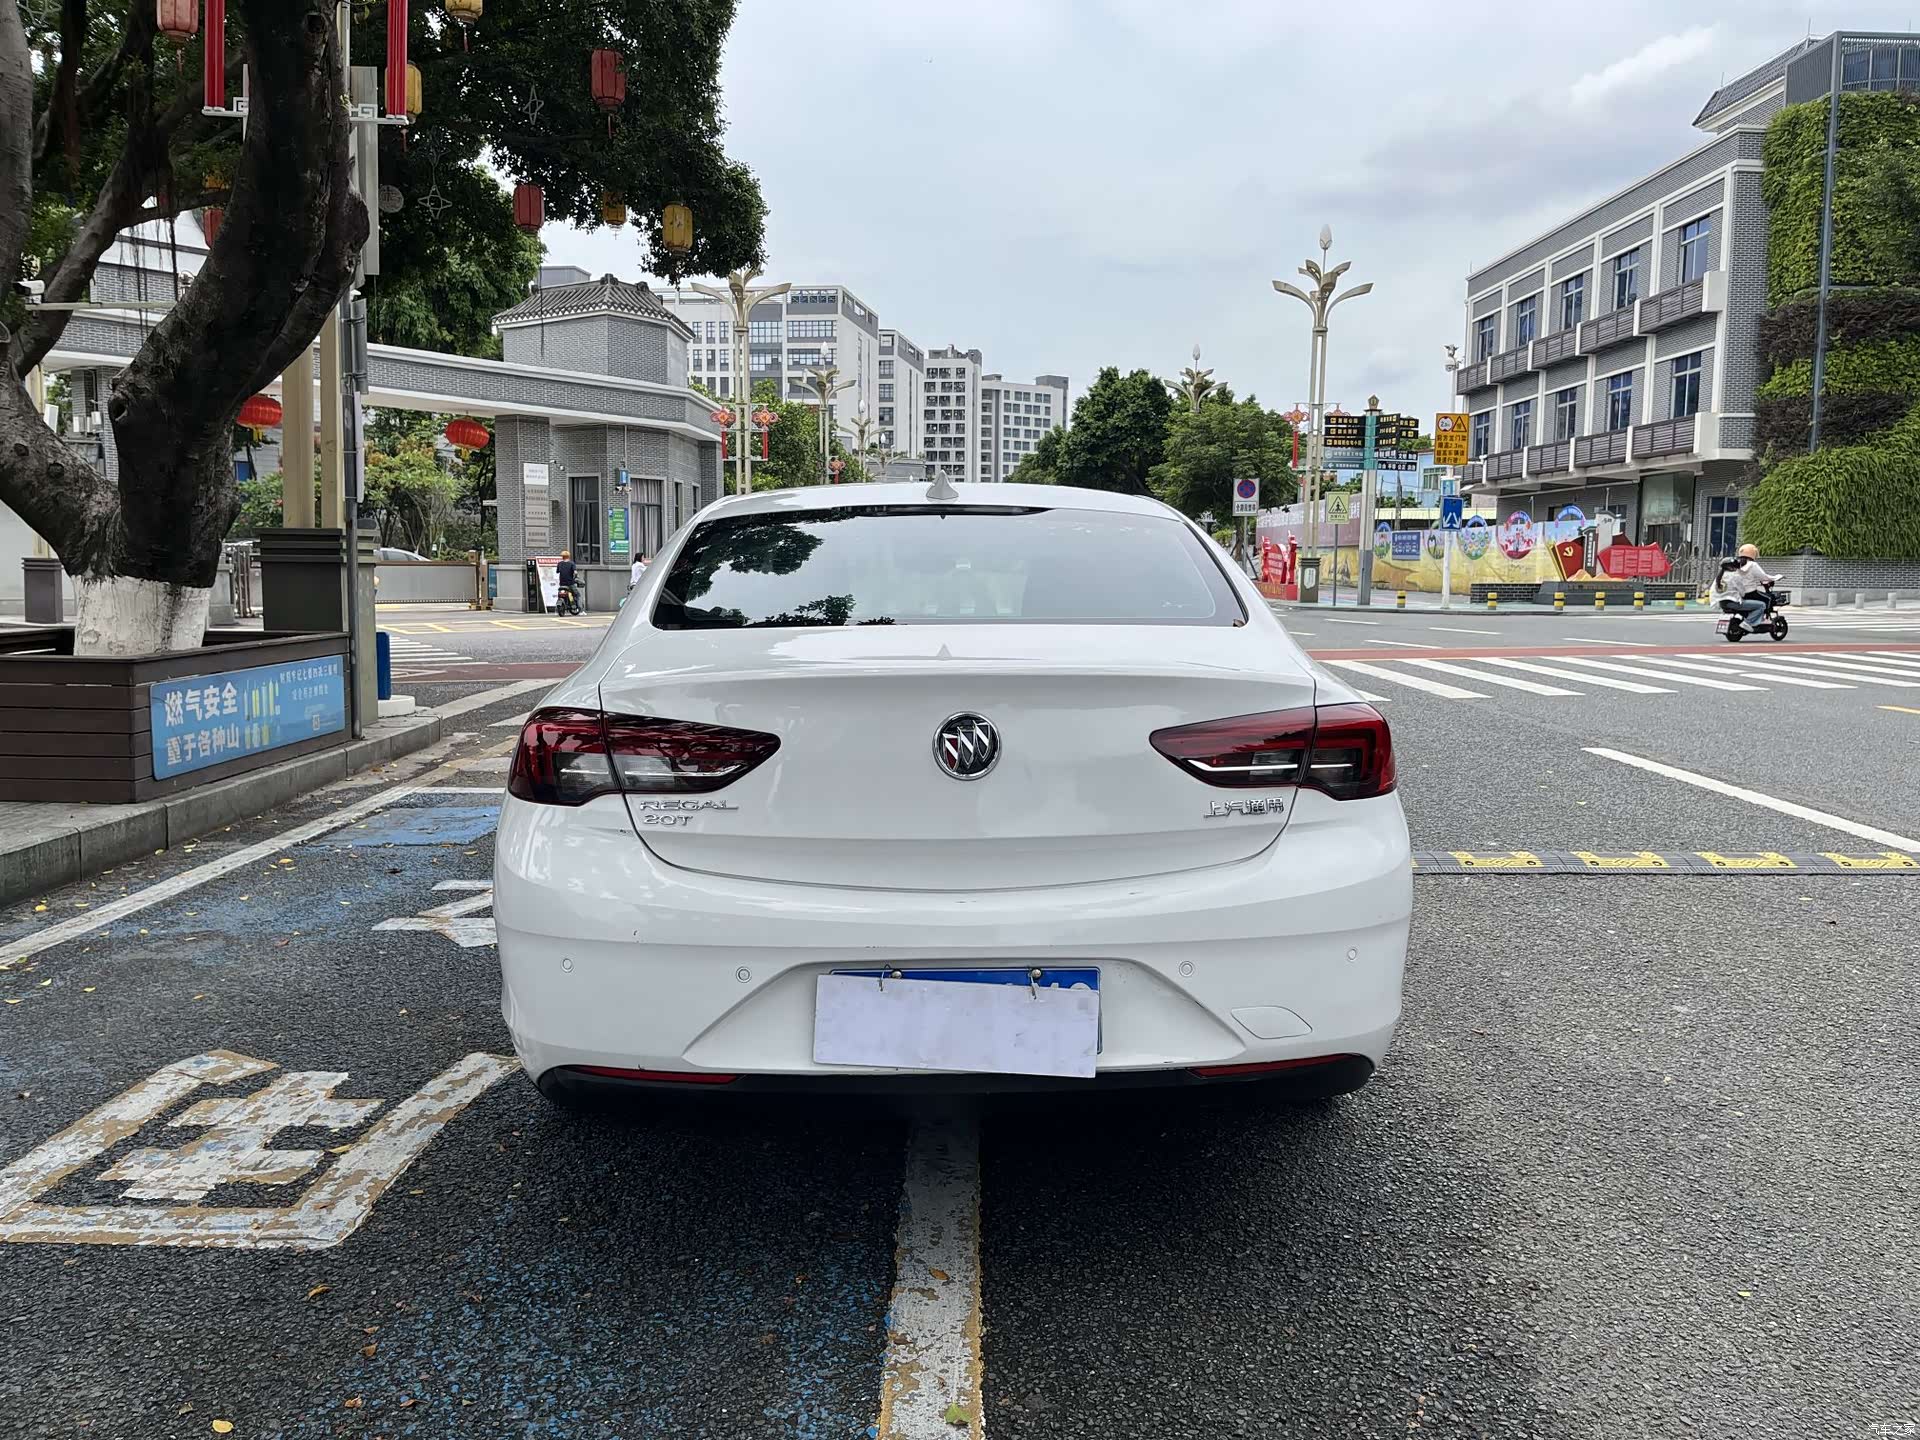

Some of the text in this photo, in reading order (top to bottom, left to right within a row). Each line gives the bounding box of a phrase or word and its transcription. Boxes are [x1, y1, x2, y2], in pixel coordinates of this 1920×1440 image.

[164, 681, 238, 726] 燃气安全
[166, 722, 239, 765] 重于各种山
[639, 799, 739, 811] REGAL
[1203, 796, 1285, 818] 上汽通用
[643, 814, 693, 826] 20T
